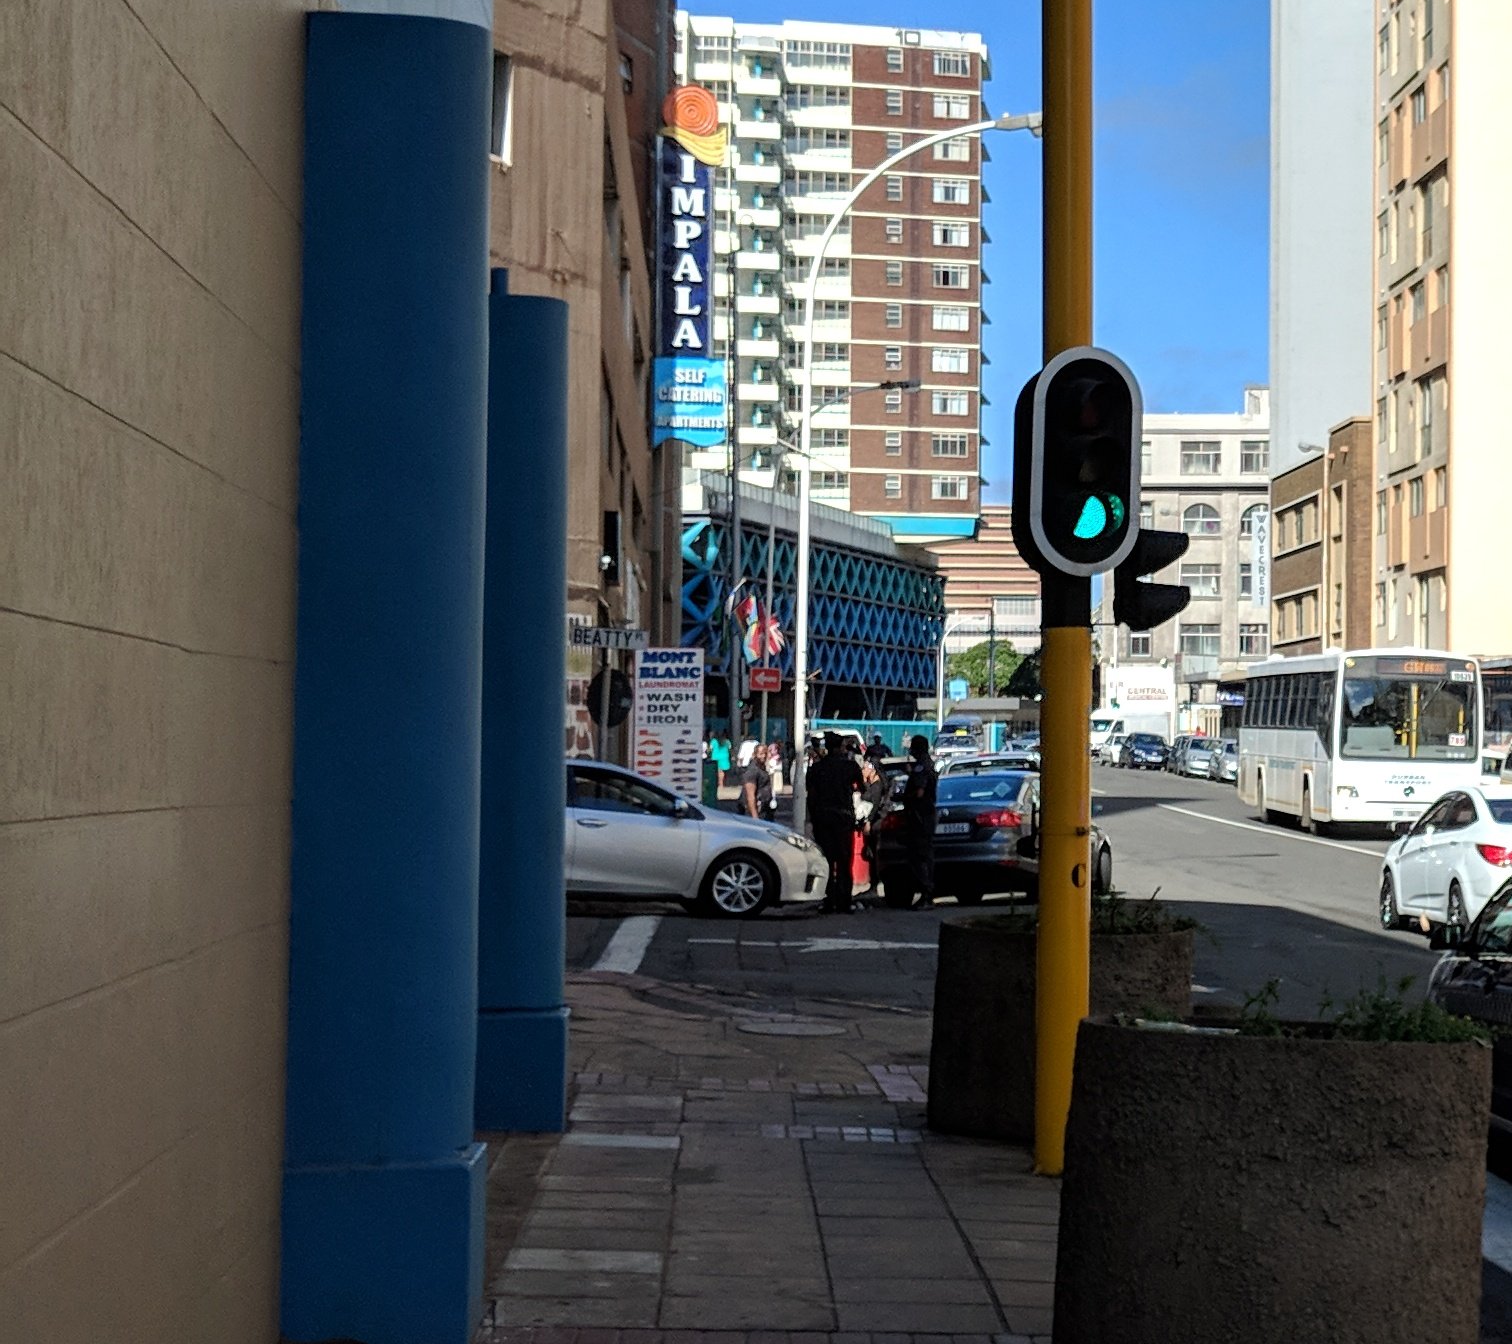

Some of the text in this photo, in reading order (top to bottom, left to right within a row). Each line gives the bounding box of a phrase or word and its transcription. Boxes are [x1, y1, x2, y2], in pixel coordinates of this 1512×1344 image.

[671, 154, 706, 348] IMPALA
[674, 367, 707, 384] SELF
[657, 386, 724, 403] CATERING
[656, 414, 726, 429] APARTMENTS
[1256, 515, 1267, 606] WAVECREST
[573, 628, 631, 647] BEATTY
[642, 651, 697, 664] MONT
[638, 666, 701, 679] BLANC
[638, 681, 699, 689] LAUNDROMAT
[1127, 687, 1167, 695] CENTRAL
[646, 693, 697, 702] WASH
[646, 704, 681, 713] DRY
[646, 715, 688, 724] IRON
